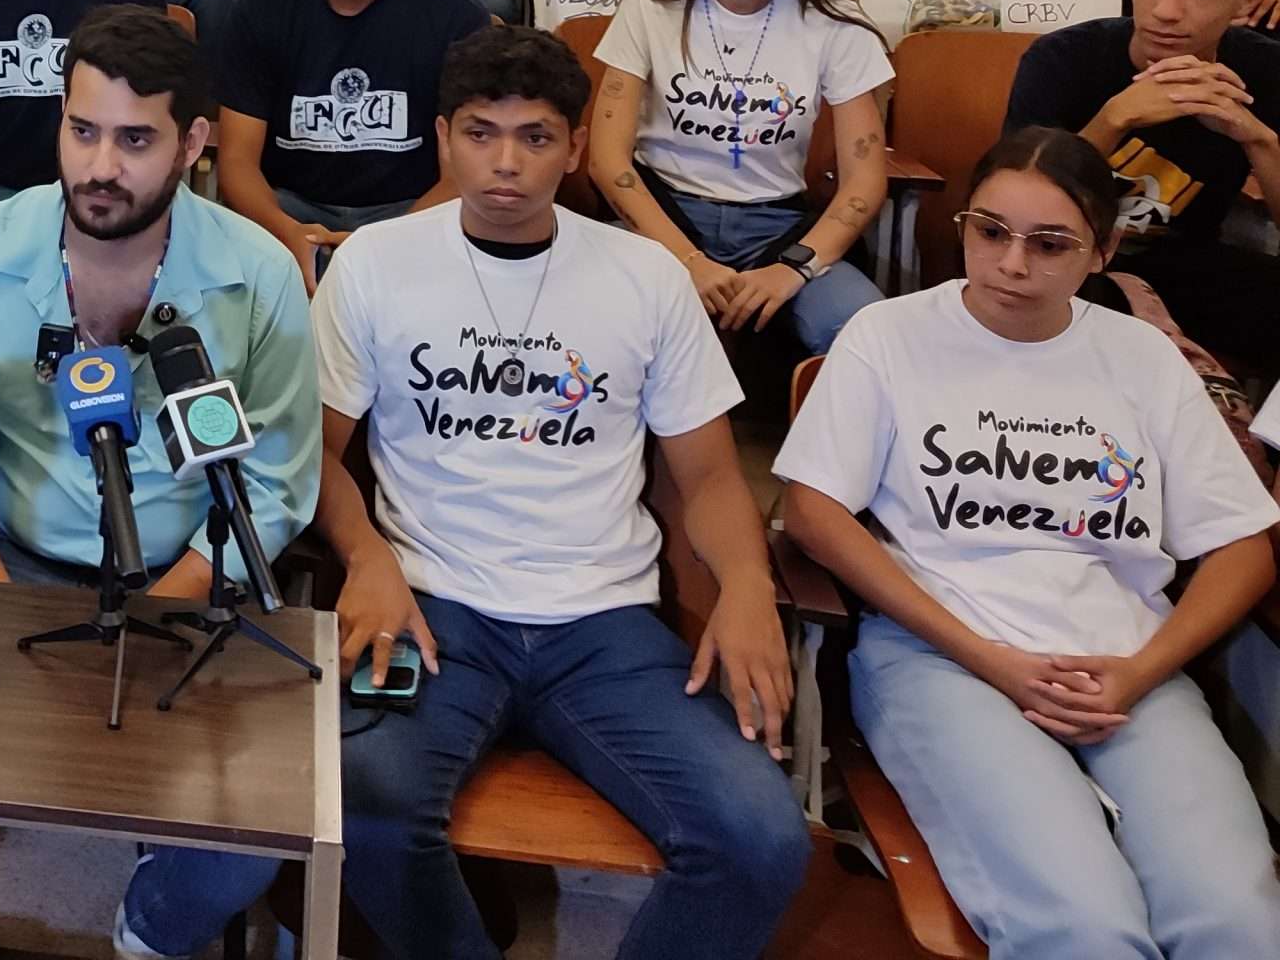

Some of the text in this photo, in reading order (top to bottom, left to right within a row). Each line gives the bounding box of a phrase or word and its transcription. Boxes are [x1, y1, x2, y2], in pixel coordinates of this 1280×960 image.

[1007, 2, 1077, 24] CRBV
[665, 73, 807, 118] Salvemos
[667, 106, 796, 146] Venezuela
[460, 327, 562, 352] Movimiento
[408, 342, 610, 404] Salvmos
[414, 397, 596, 447] Venezuela
[978, 410, 1097, 437] Movimiento
[919, 424, 1146, 492] Salvemos
[924, 483, 1151, 541] Venezuela
